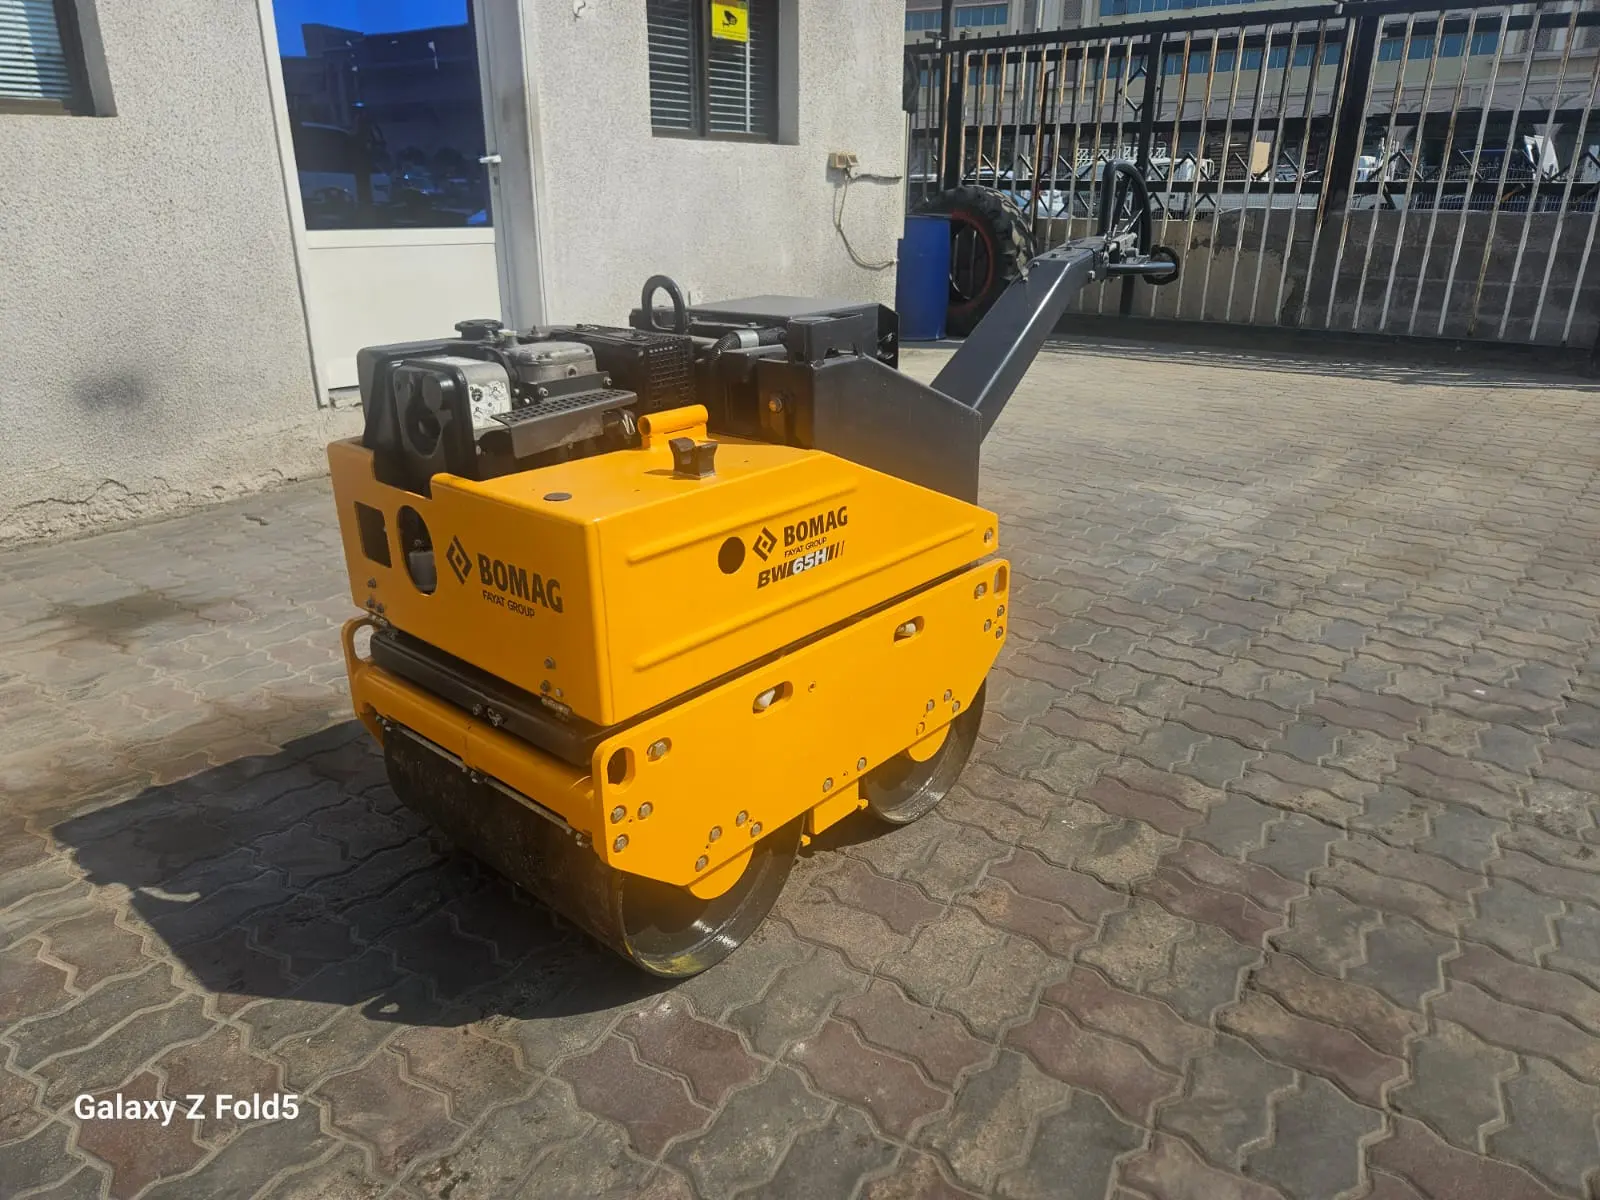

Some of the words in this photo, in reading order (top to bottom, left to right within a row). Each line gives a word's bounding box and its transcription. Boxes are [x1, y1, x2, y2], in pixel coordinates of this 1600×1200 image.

[783, 506, 848, 547] BOMAG
[784, 545, 803, 558] FAYAT
[805, 536, 827, 550] GROUP
[477, 552, 563, 613] BOMAG
[482, 589, 505, 607] FAYAT
[507, 600, 535, 618] GROUP
